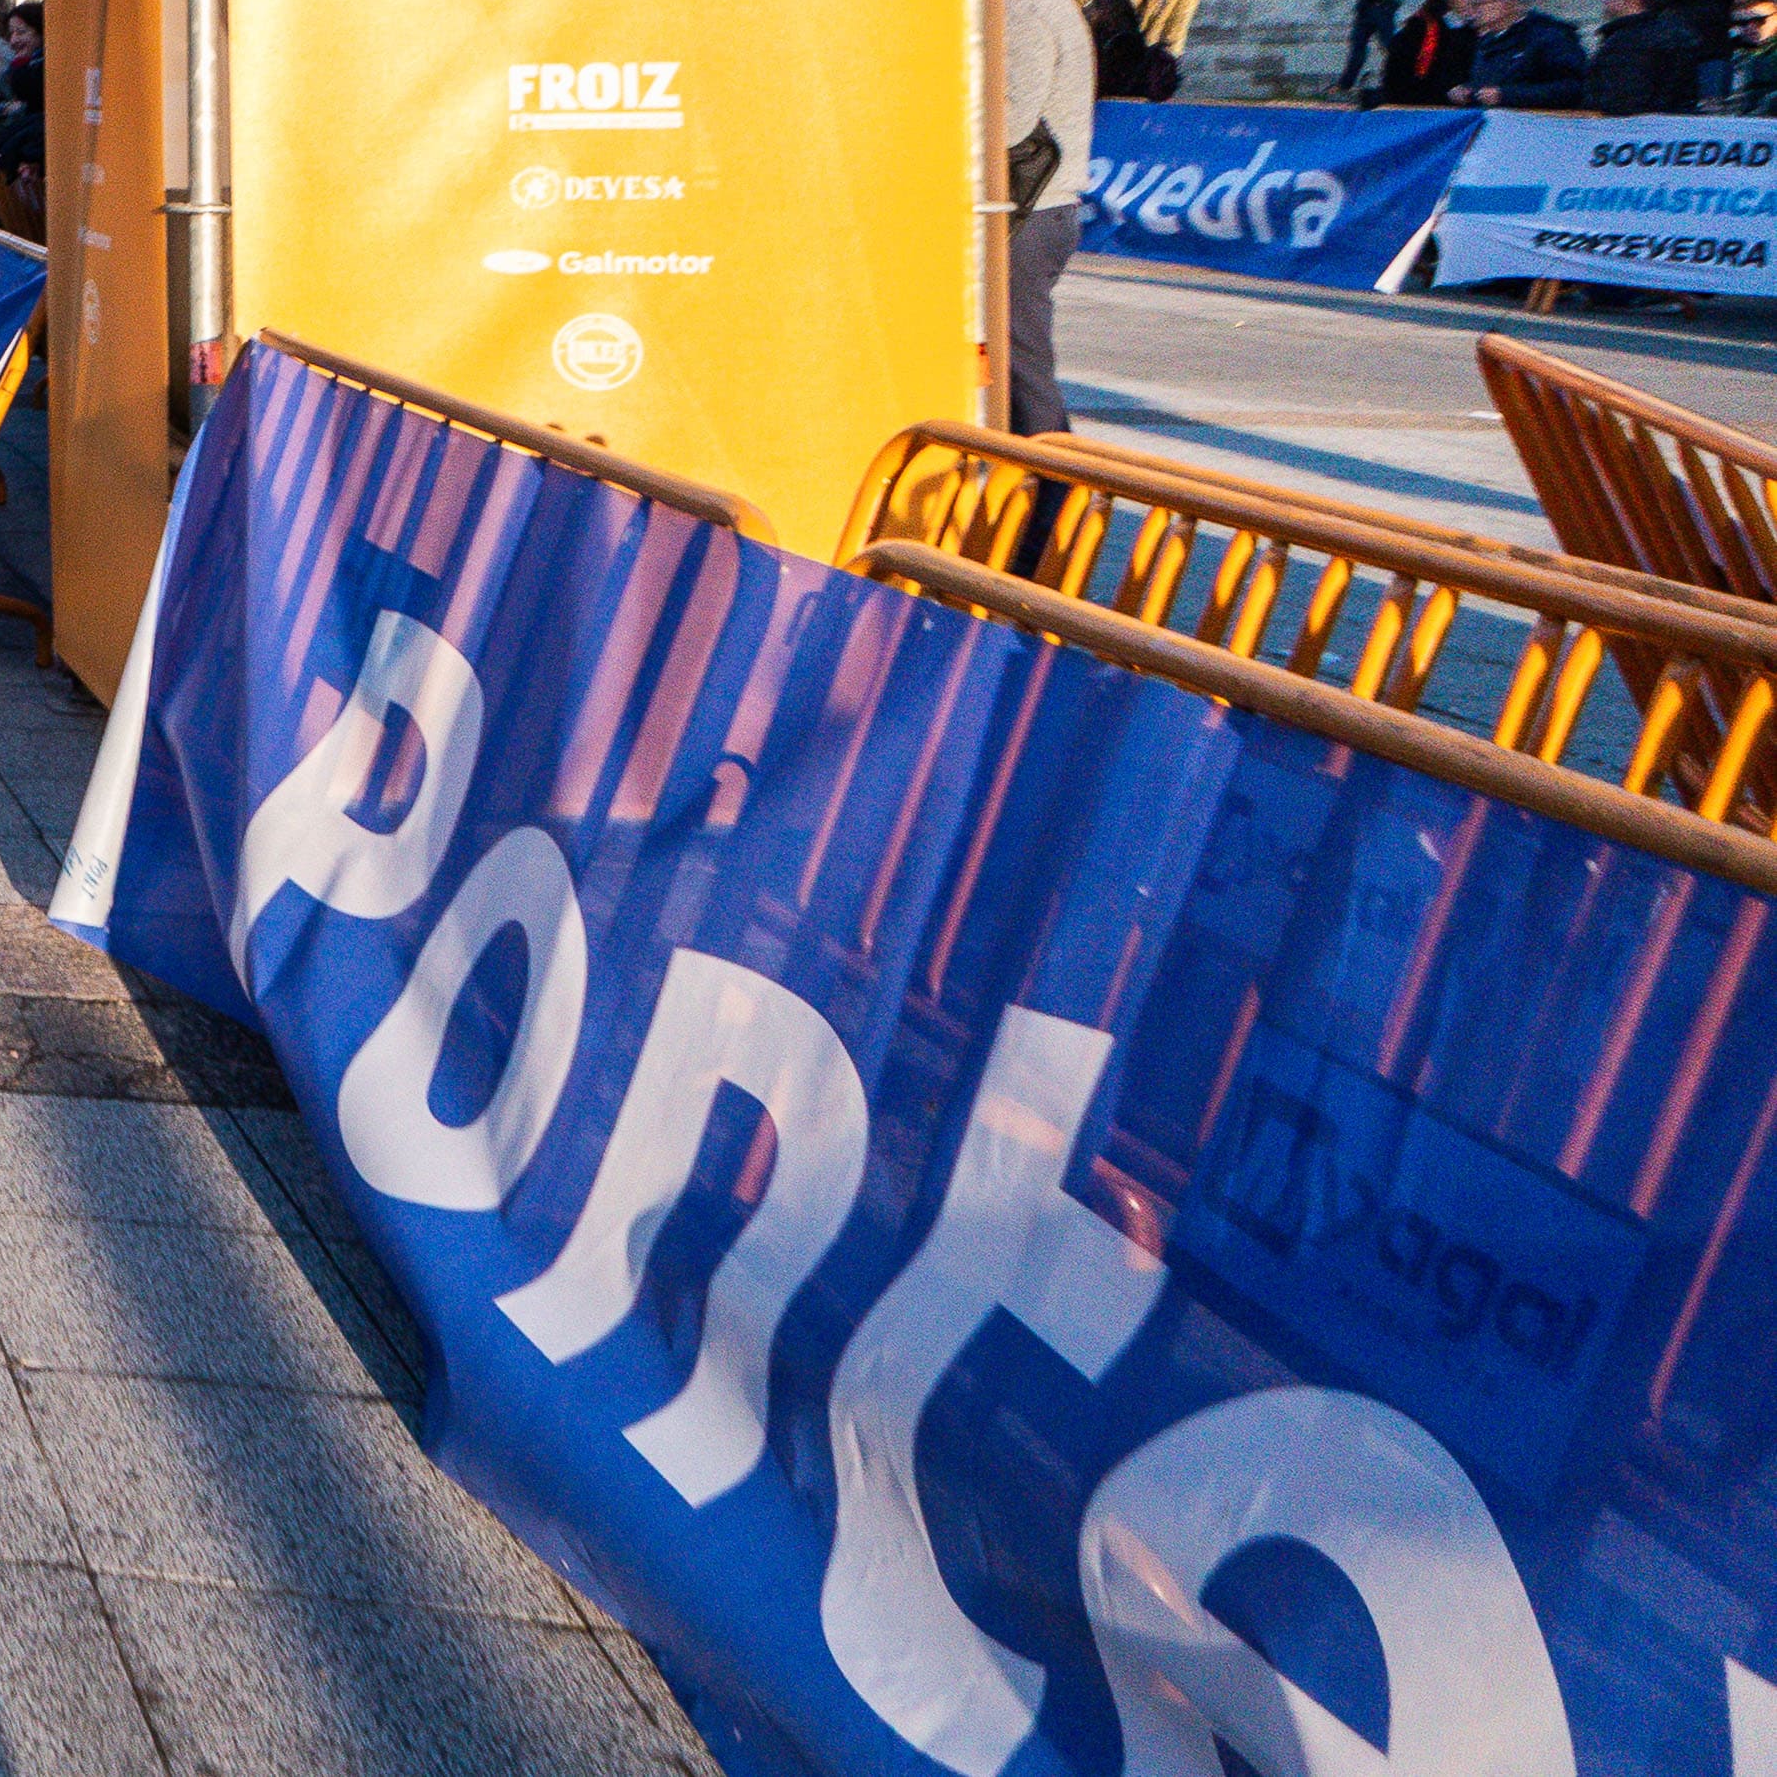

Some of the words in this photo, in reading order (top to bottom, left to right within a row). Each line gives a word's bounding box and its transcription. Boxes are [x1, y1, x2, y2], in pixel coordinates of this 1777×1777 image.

[508, 61, 682, 111] FROIZ
[1589, 139, 1774, 169] SOCIEDAD
[556, 249, 715, 275] Galmotor
[240, 610, 1777, 1777] Ponte
